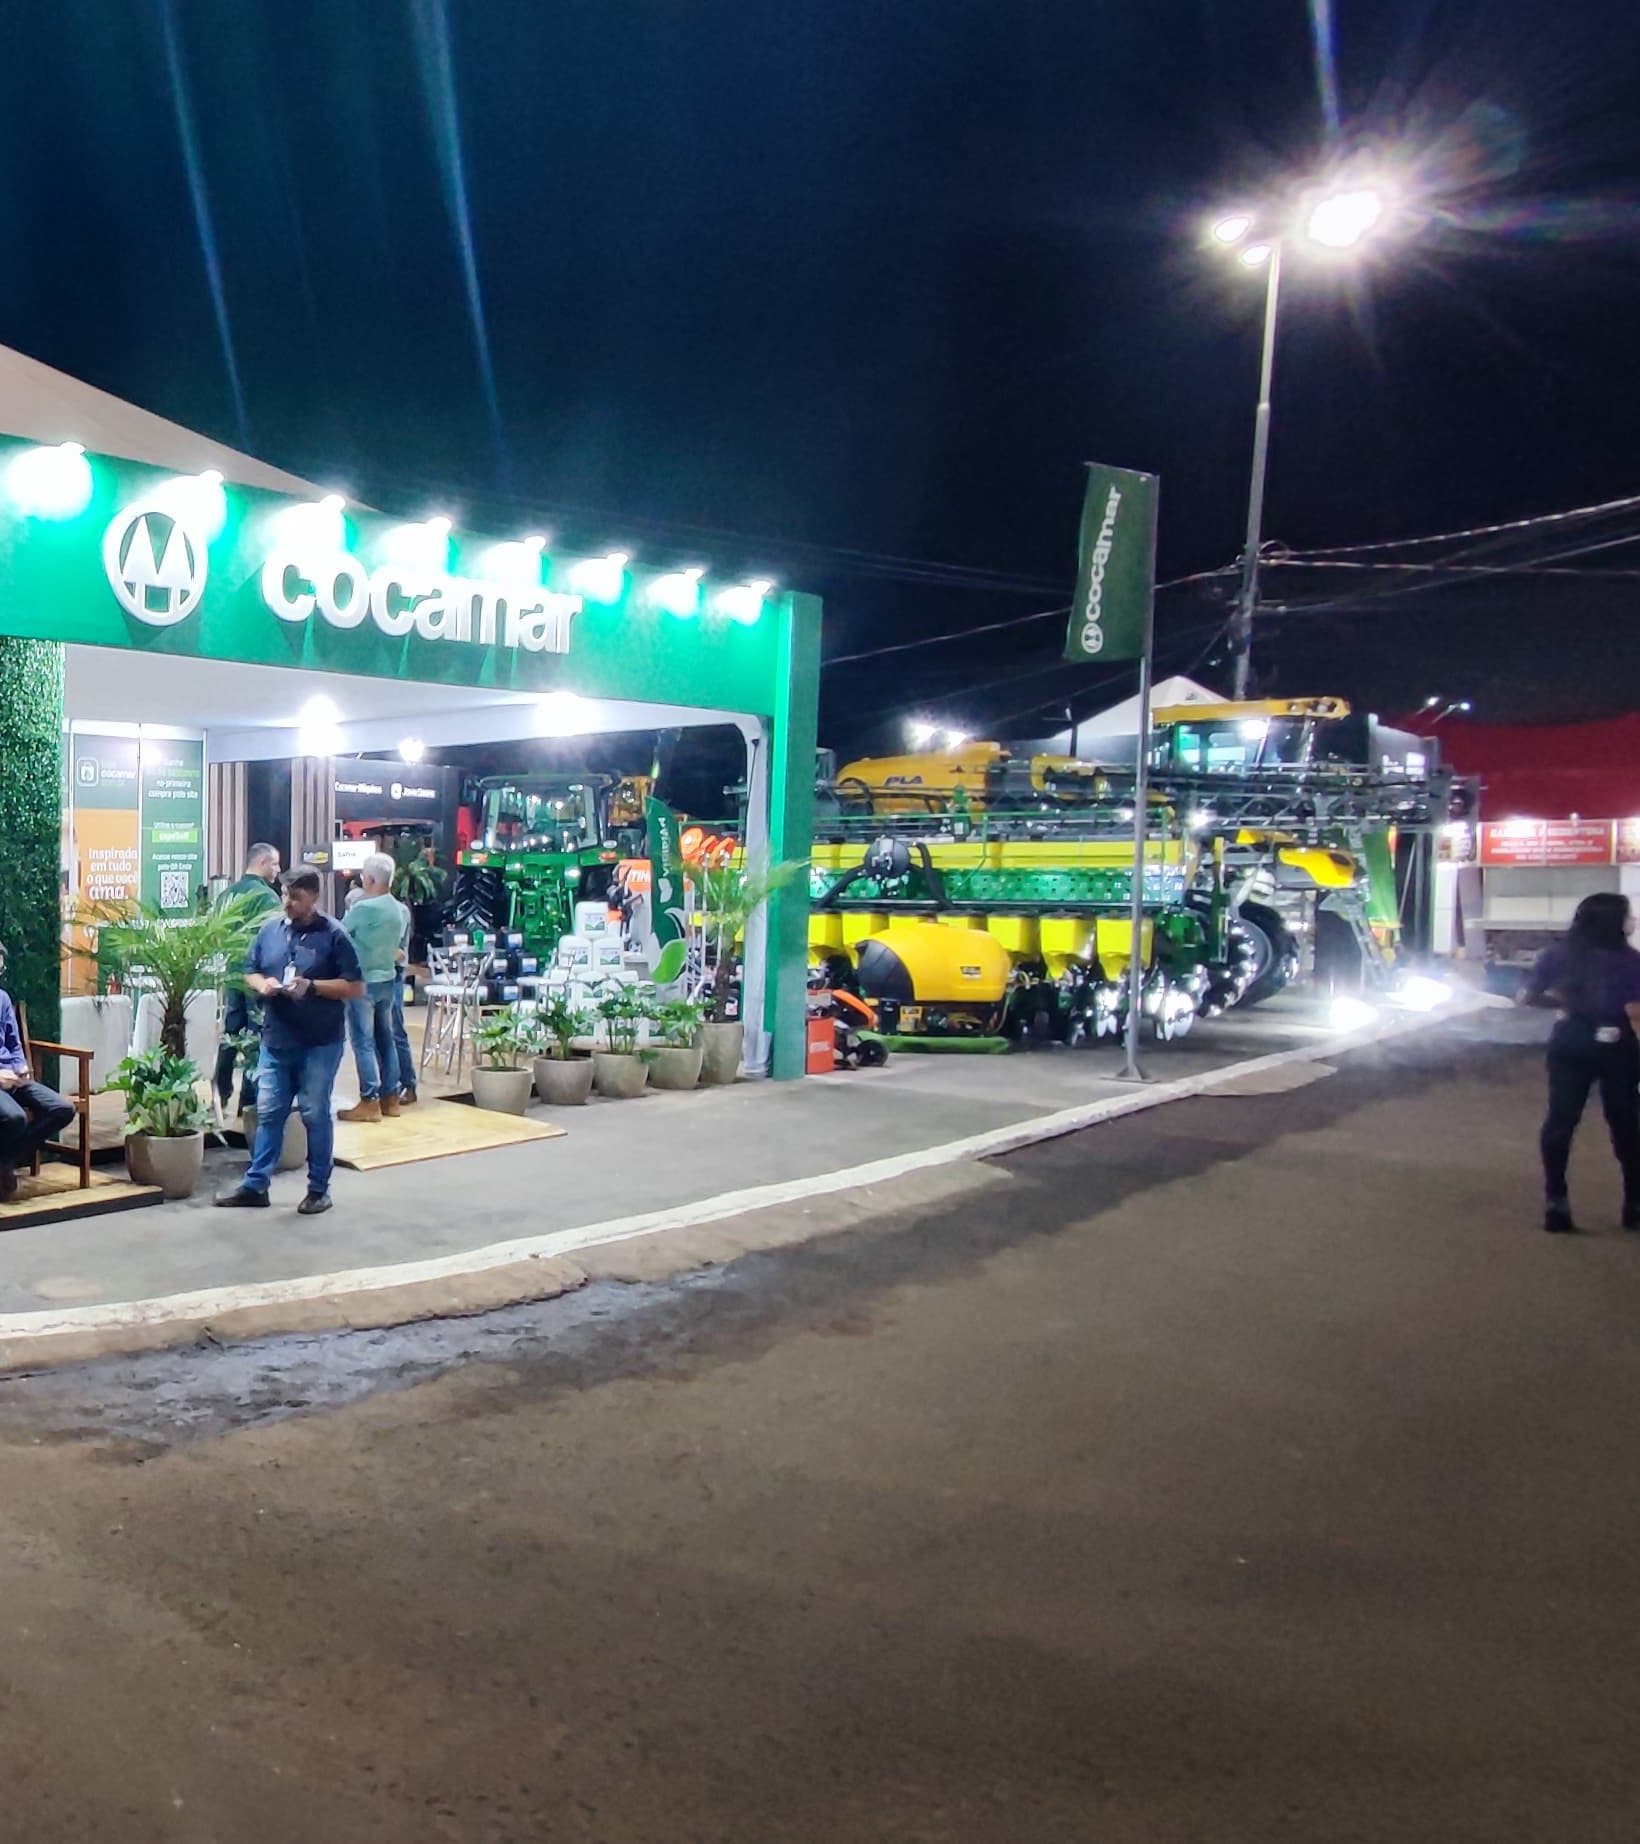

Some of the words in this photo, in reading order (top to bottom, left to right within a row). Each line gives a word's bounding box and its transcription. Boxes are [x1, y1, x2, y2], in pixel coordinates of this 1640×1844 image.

[1086, 485, 1121, 621] cocamar
[261, 551, 584, 654] cocamar
[885, 775, 923, 786] PLA
[88, 848, 137, 861] Inspirado
[90, 862, 107, 871] em
[108, 860, 132, 871] tudo
[87, 875, 94, 884] o
[95, 874, 114, 888] que
[89, 885, 129, 900] ama.
